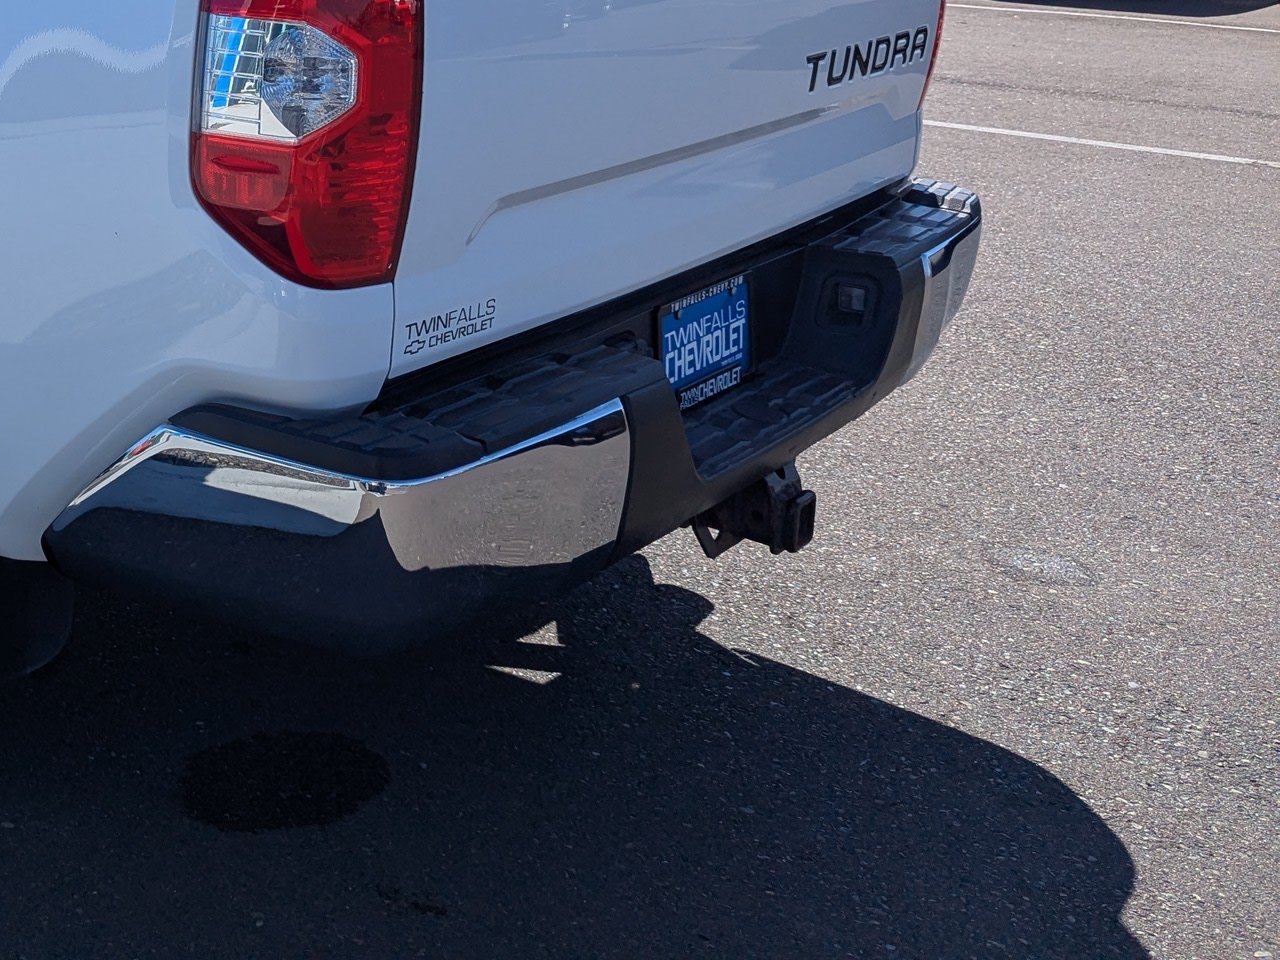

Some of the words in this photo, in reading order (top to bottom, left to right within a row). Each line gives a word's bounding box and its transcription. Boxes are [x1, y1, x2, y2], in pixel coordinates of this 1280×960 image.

[806, 25, 928, 93] TUNDRA
[428, 317, 495, 348] CHEVROLET
[665, 318, 746, 383] CHEVROLET
[699, 366, 742, 401] CHEVROLET
